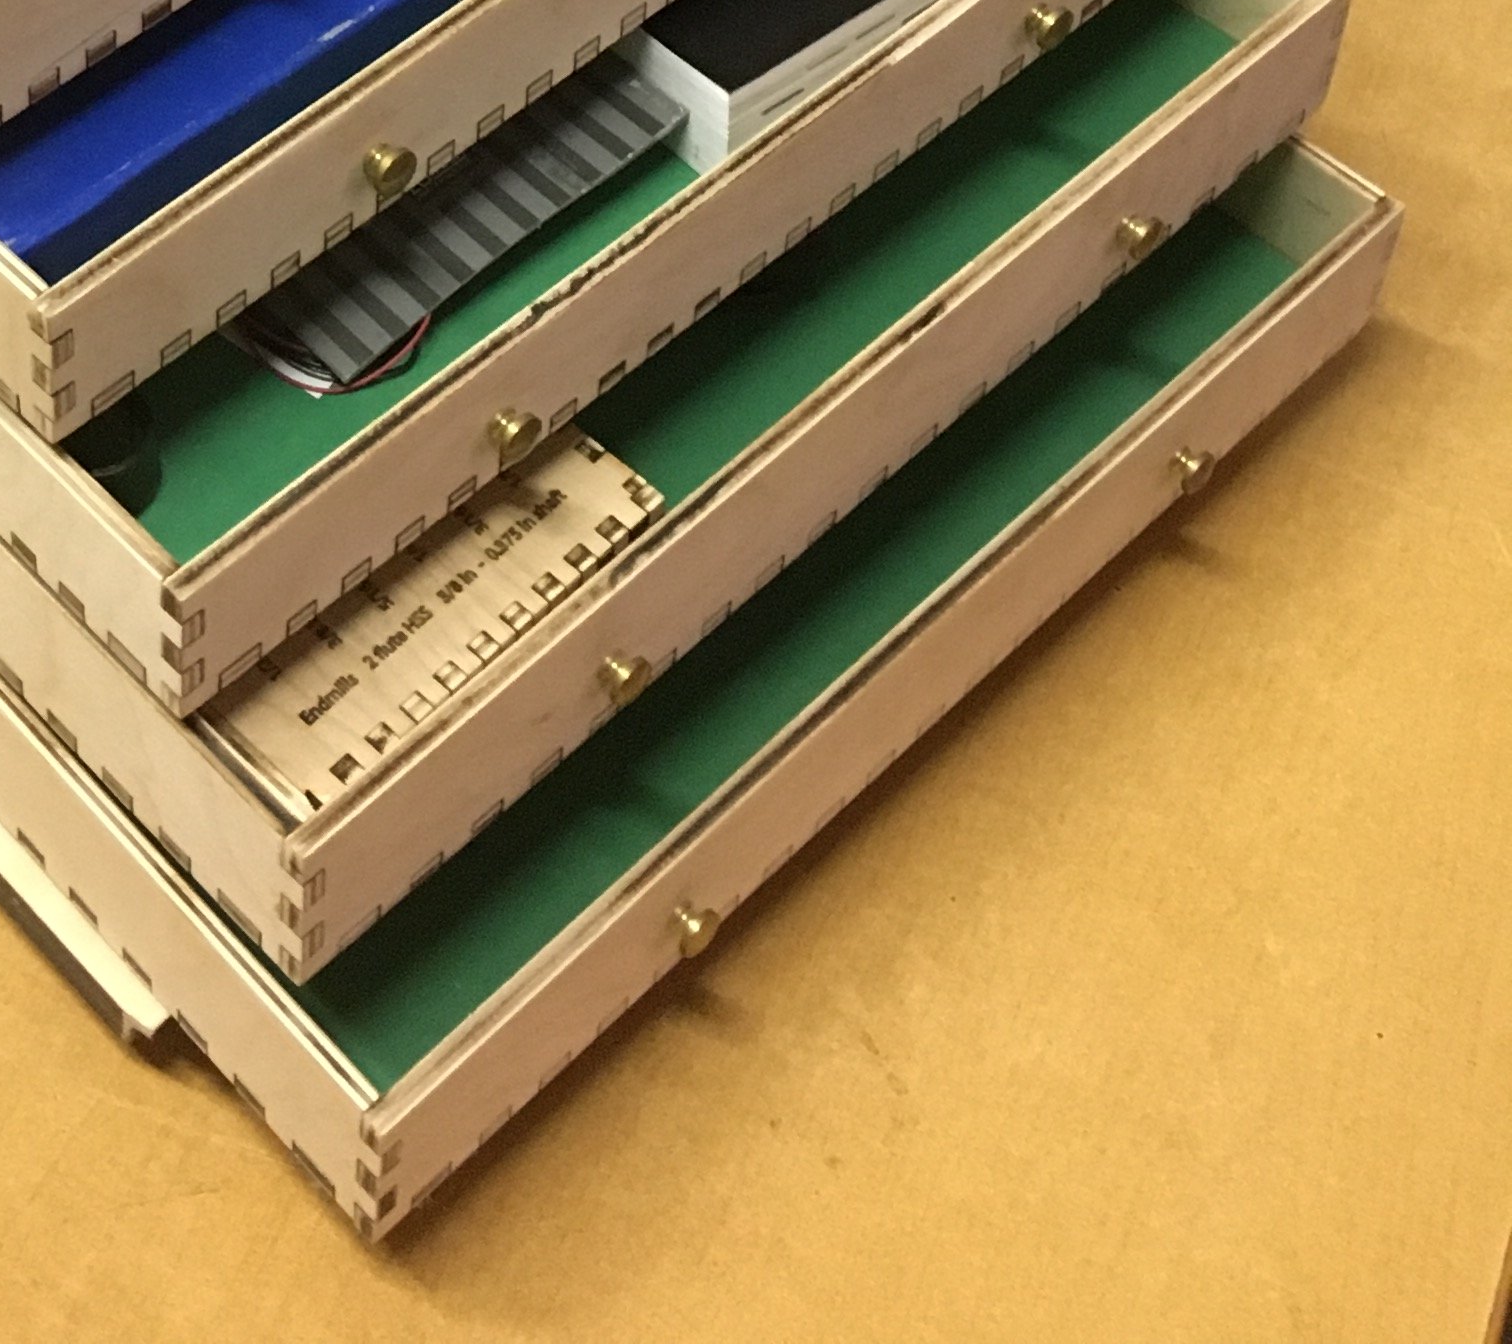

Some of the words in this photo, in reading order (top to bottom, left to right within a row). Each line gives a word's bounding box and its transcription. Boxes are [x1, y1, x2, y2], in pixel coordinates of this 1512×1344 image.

[298, 673, 359, 726] Endmills
[362, 655, 379, 671] 2
[401, 605, 434, 634] HSS
